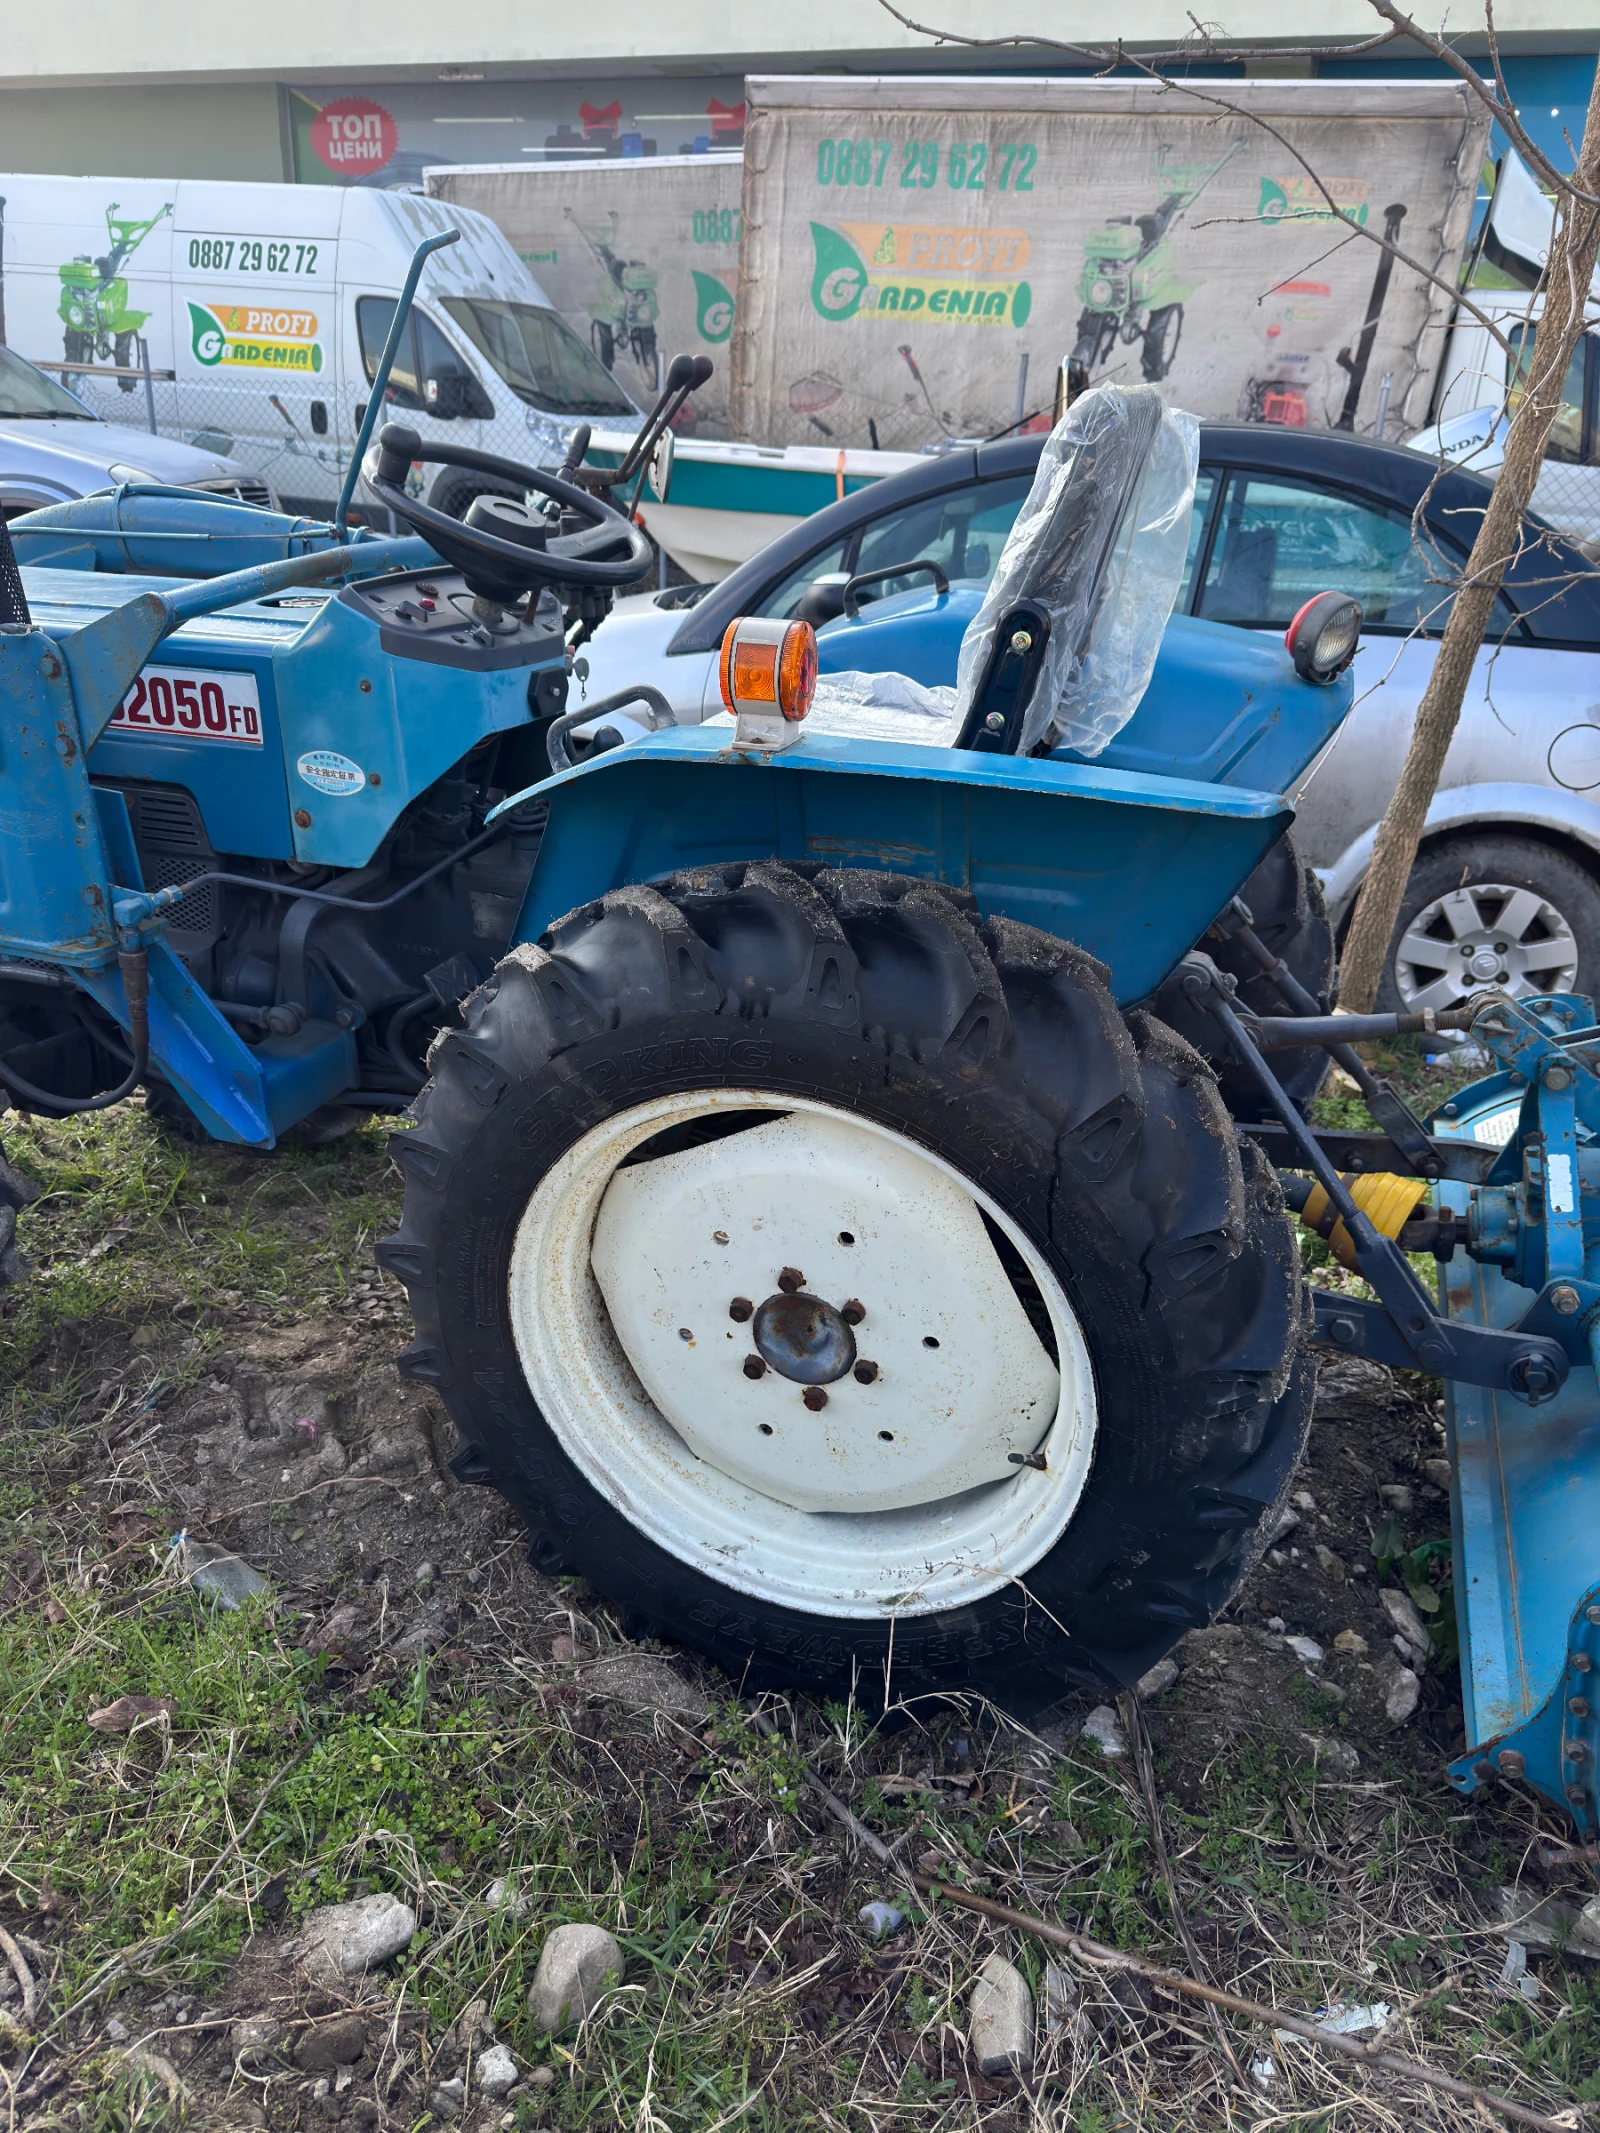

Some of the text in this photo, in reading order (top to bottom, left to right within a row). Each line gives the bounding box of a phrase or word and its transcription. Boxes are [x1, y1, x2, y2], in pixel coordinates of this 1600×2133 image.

[326, 114, 382, 140] ТОП
[328, 141, 382, 162] ЦЕНИ
[817, 139, 1038, 191] 0887 29 62 72
[188, 238, 318, 275] 0887 29 62 72
[906, 232, 1023, 268] PROFI
[245, 311, 313, 335] PROFI
